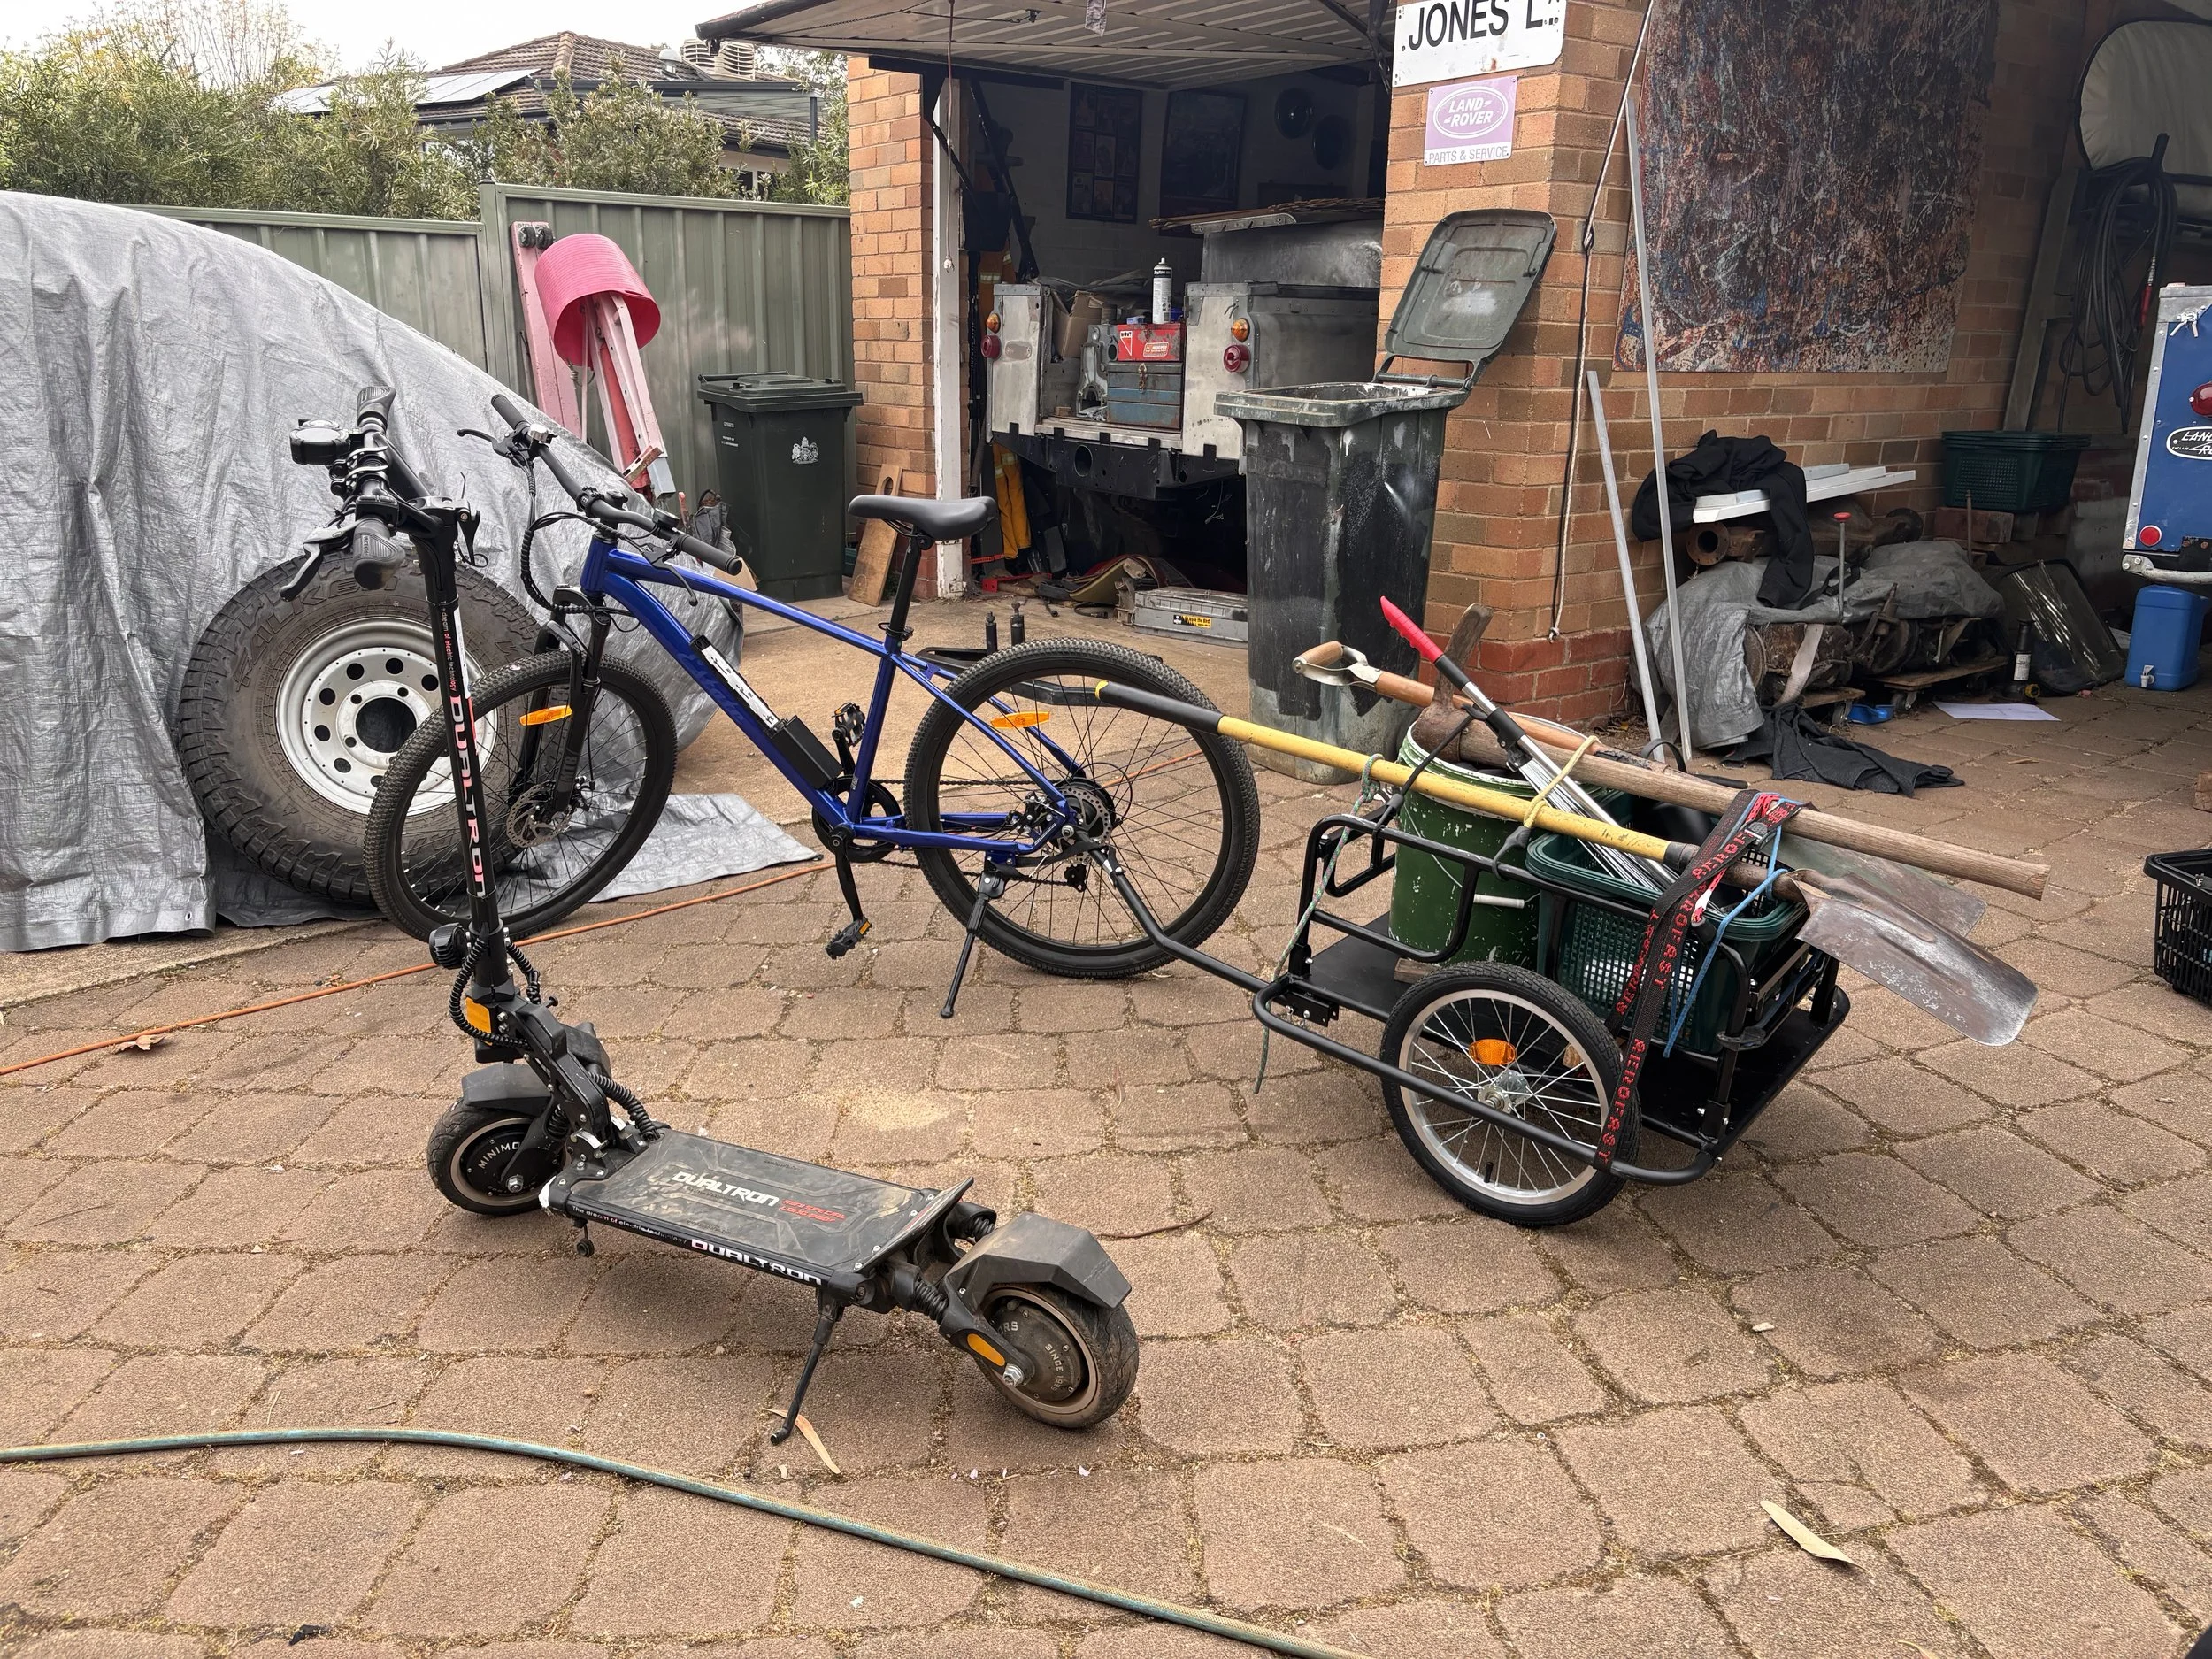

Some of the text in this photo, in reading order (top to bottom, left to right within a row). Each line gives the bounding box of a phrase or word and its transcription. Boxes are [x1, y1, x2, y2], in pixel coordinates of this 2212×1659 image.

[1409, 0, 1509, 50] JONES
[1448, 97, 1484, 113] LAND
[1450, 110, 1494, 127] ROVER
[1428, 145, 1508, 165] PARTS & SERVICE
[449, 695, 486, 897] DUALTRON
[477, 1141, 521, 1170] MINIMO
[671, 1171, 780, 1207] DUALTRON
[572, 1205, 585, 1214] The
[586, 1210, 610, 1222] dream
[691, 1238, 822, 1286] DUALTRON
[1044, 1343, 1064, 1372] SINCE
